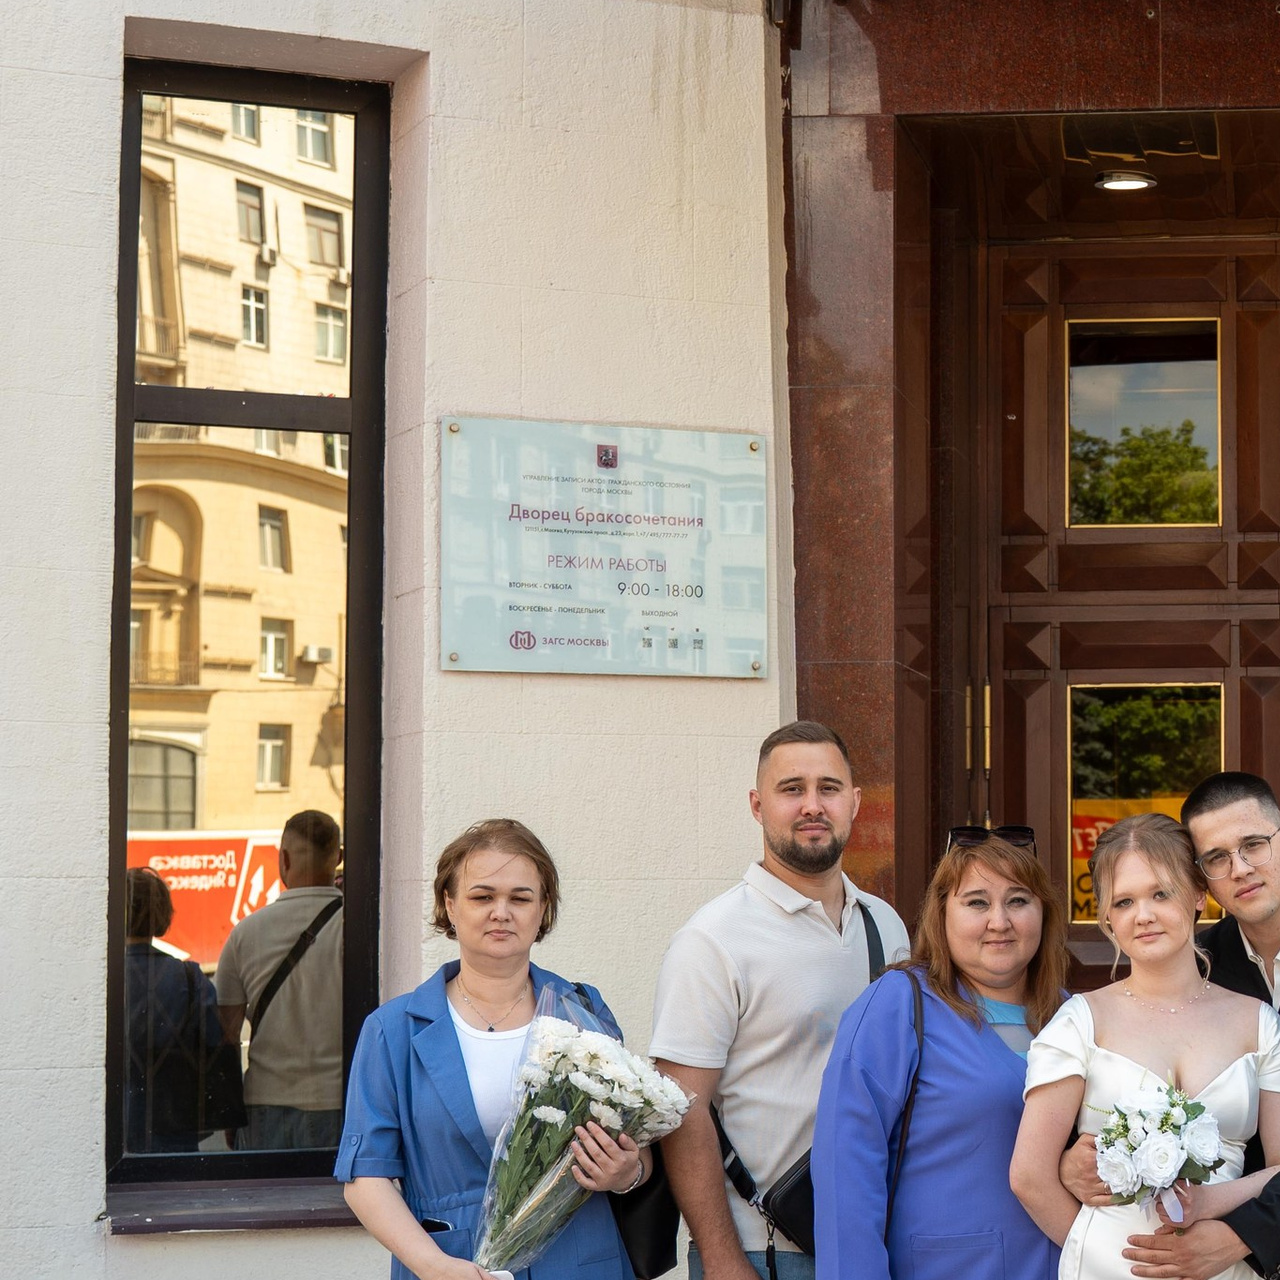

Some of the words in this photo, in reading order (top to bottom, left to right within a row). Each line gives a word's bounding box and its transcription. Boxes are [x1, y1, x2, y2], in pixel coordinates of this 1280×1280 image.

[561, 476, 586, 484] ЗАПИСИ
[608, 479, 654, 487] ГРАЖДАНСКОГО
[581, 487, 605, 495] ГОРОДА
[606, 488, 633, 496] МОСКВЫ
[509, 503, 571, 524] Дворец
[575, 506, 703, 528] бракосочетания
[547, 554, 604, 570] РЕЖИМ
[609, 557, 667, 573] РАБОТЫ
[508, 581, 538, 589] ВТОРНИК
[543, 582, 572, 591] СУББОТА
[617, 581, 650, 596] 9:00
[665, 584, 704, 599] 18:00
[508, 604, 553, 613] ВОСКРЕСЕНЬЕ
[558, 606, 606, 615] ПОНЕДЕЛЬНИК
[641, 609, 678, 618] ВЫХОДНОЙ
[542, 637, 565, 646] ЗАГС
[567, 638, 609, 647] МОСКВЫ
